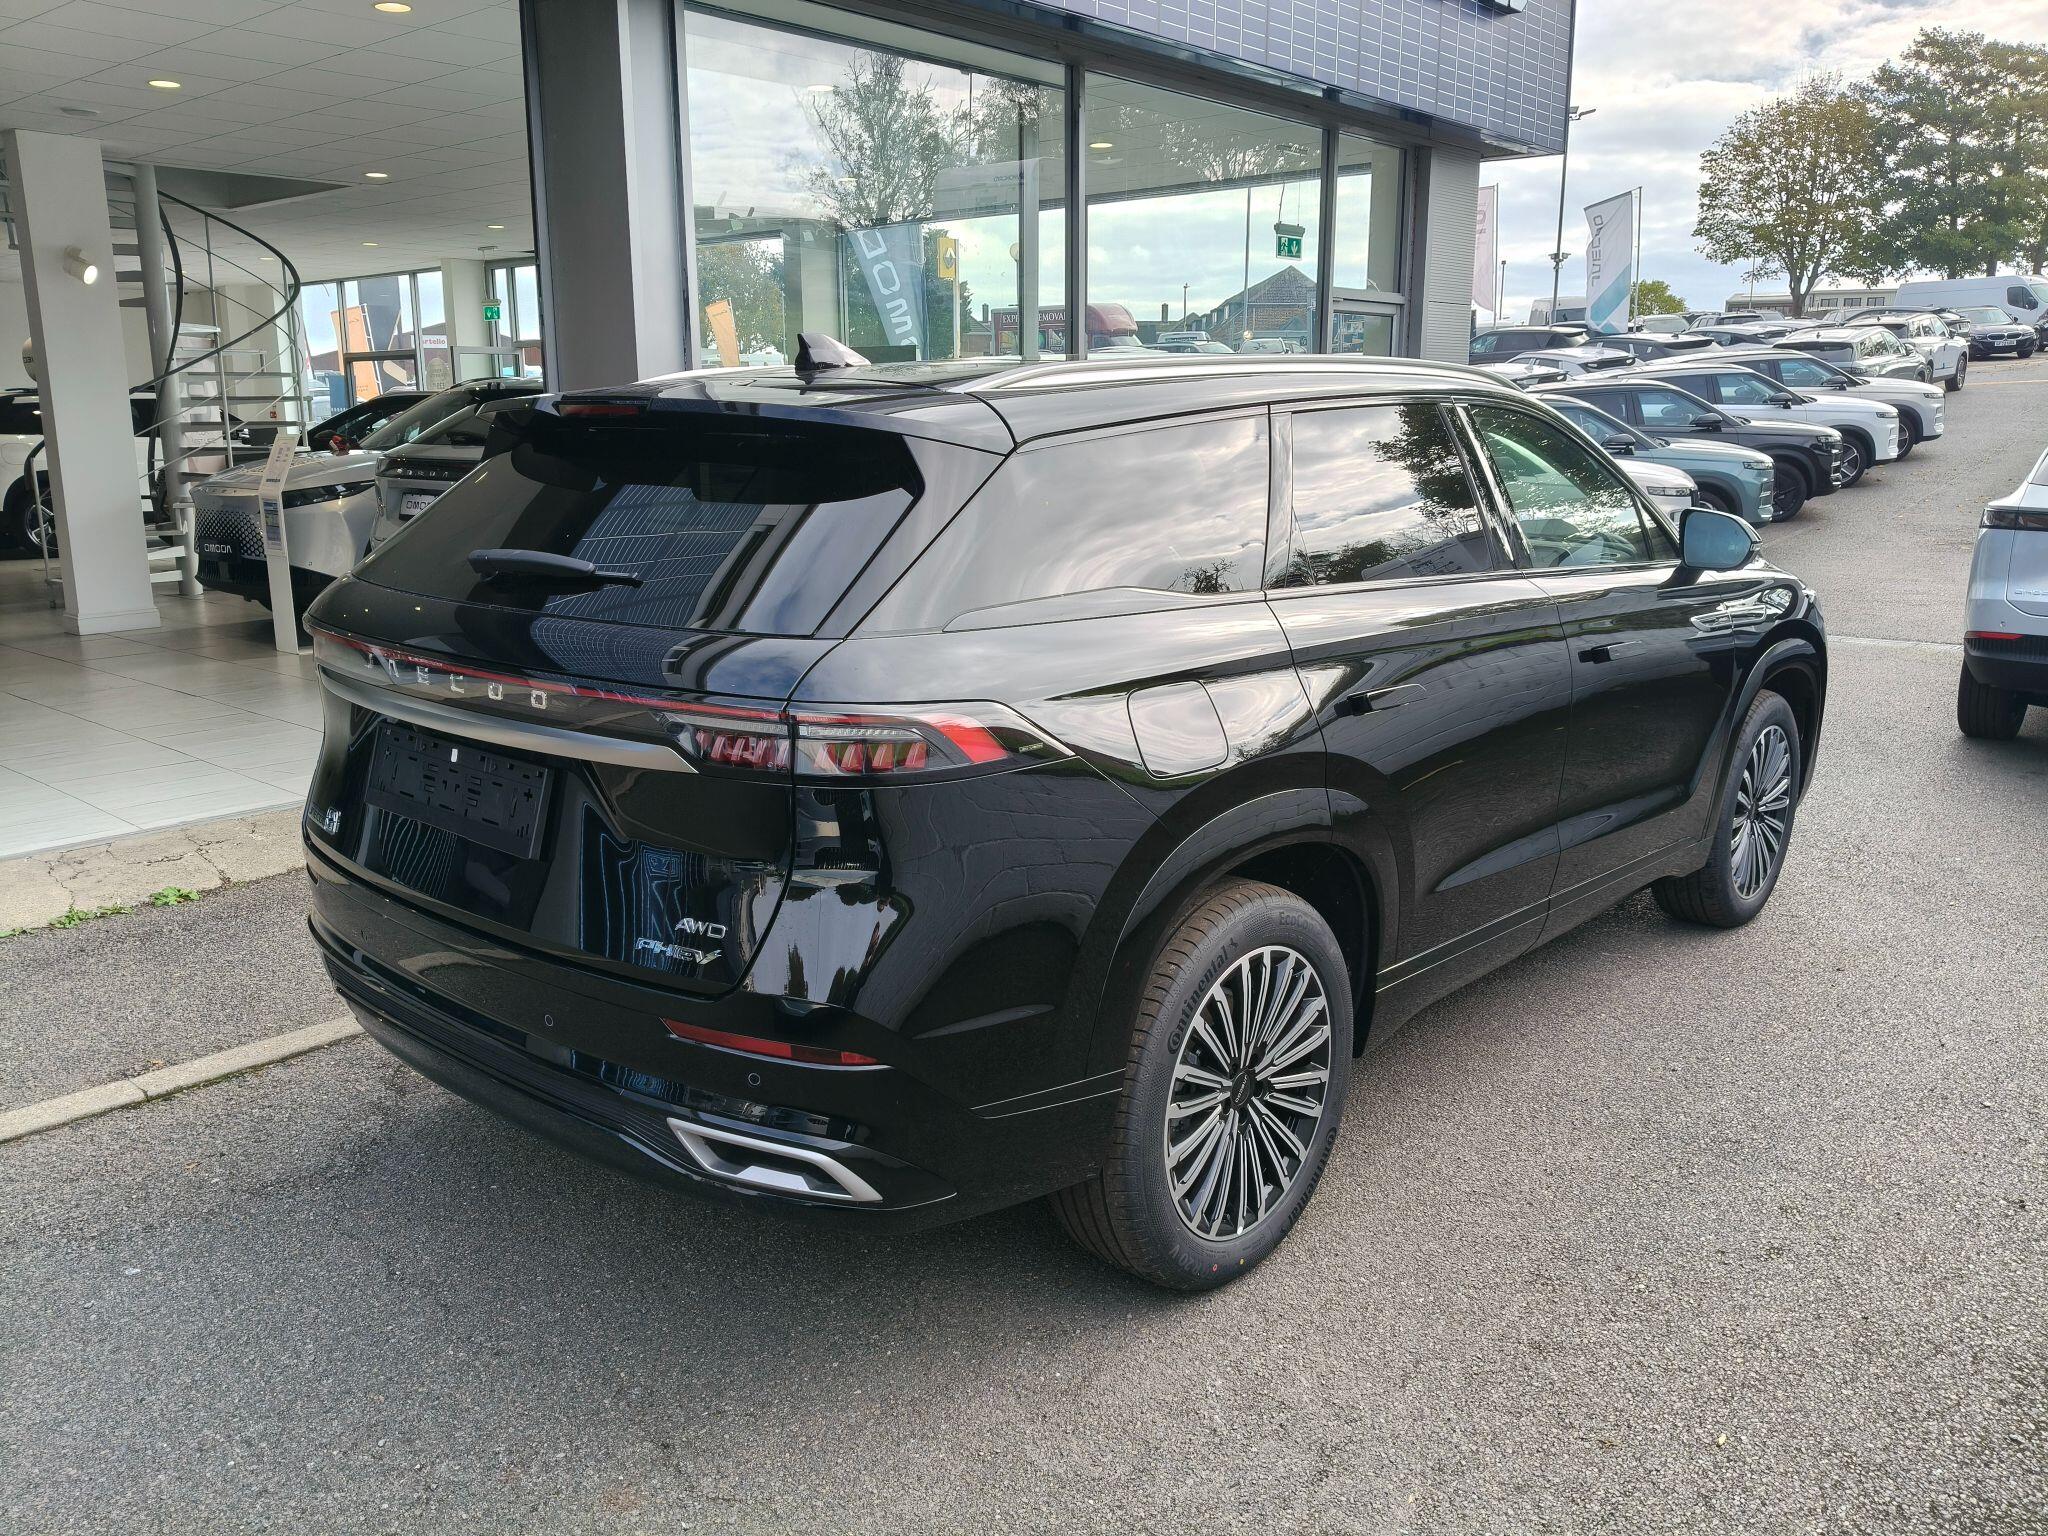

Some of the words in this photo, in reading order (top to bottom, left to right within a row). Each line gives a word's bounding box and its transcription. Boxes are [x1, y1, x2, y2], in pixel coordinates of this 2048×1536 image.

[204, 543, 232, 553] OMODA
[675, 917, 727, 939] AWD
[634, 937, 722, 965] PHEV
[1167, 944, 1229, 1056] Continental
